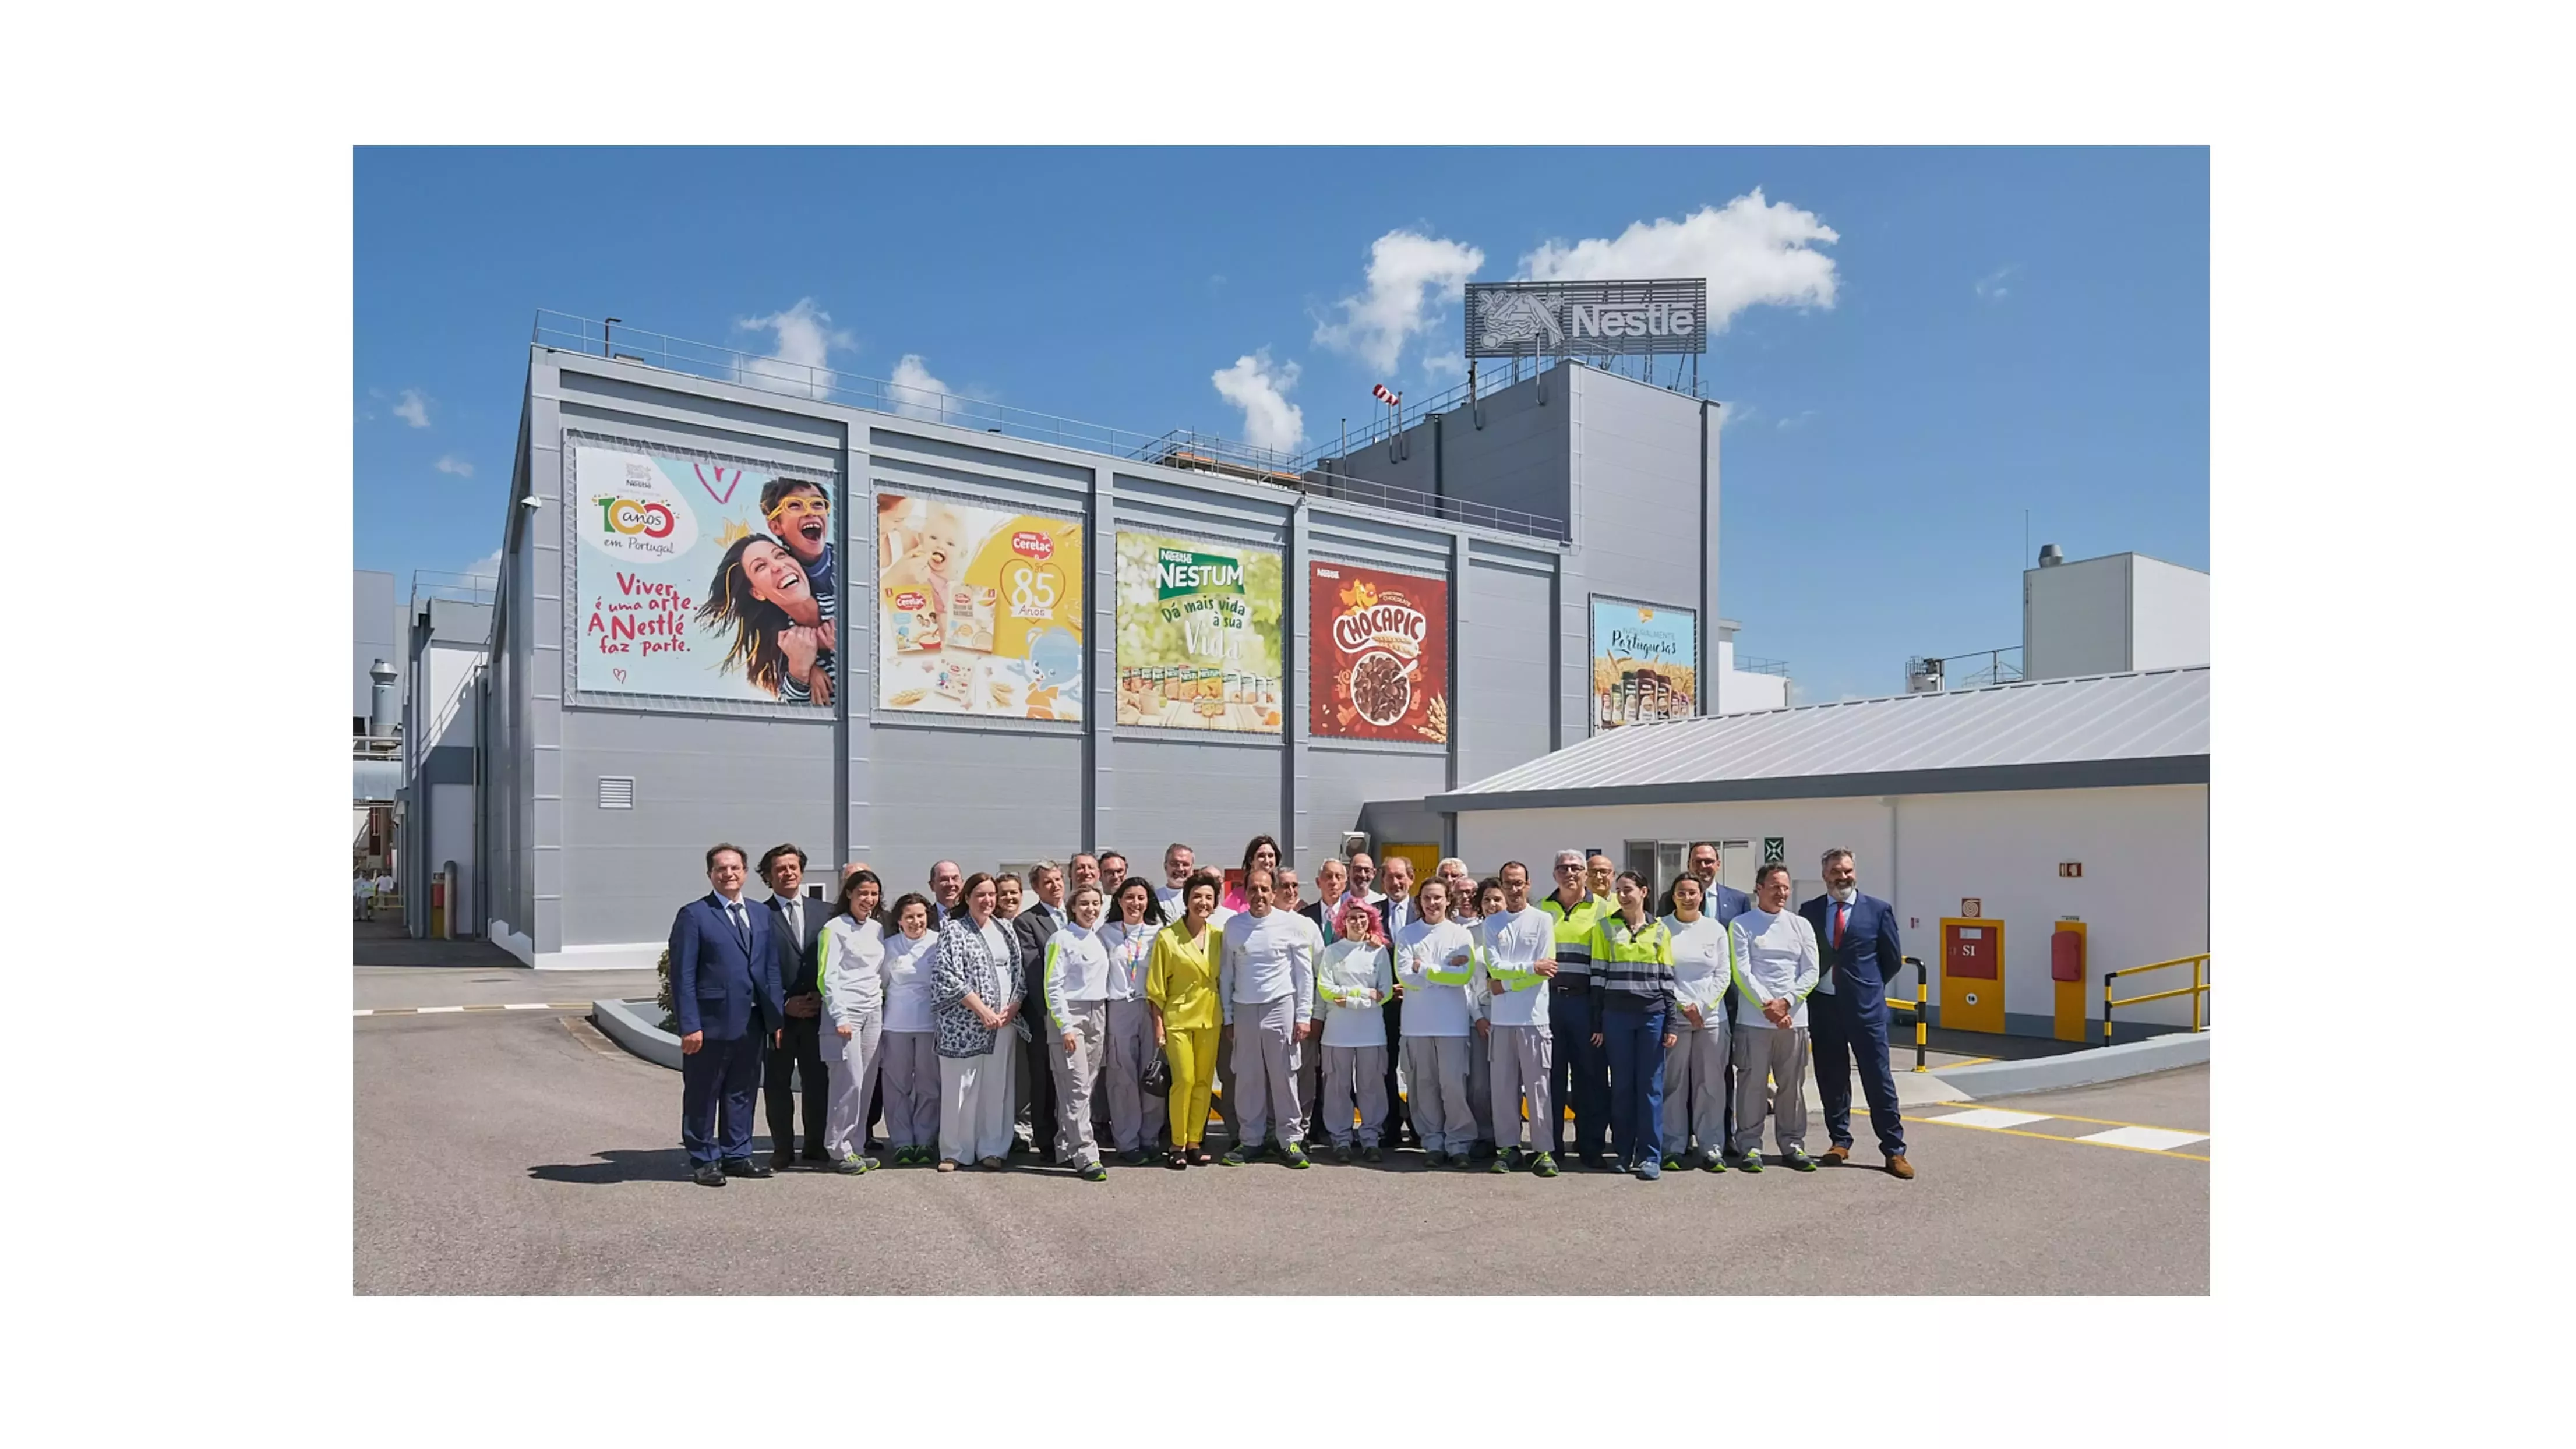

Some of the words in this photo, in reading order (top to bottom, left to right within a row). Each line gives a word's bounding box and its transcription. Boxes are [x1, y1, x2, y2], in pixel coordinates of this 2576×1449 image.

[623, 512, 661, 525] anos
[604, 539, 623, 547] em
[629, 536, 675, 556] Portugal
[1014, 538, 1051, 553] Cerelac
[616, 571, 673, 596] Viver
[1012, 568, 1054, 607] 85
[1156, 563, 1244, 589] NESTUM
[595, 596, 602, 610] é
[609, 602, 643, 612] uma
[648, 590, 698, 612] arte.
[1162, 602, 1181, 623] Dá
[1184, 595, 1214, 613] mais
[1218, 597, 1245, 616] vida
[588, 612, 605, 632] A
[612, 610, 684, 640] Nestlé
[1224, 617, 1243, 630] sua
[1336, 607, 1423, 650] CHOCAPIC
[600, 635, 630, 653] faz
[642, 634, 690, 657] parte.
[1612, 630, 1676, 659] Portuguesas
[1963, 945, 1975, 956] SI
